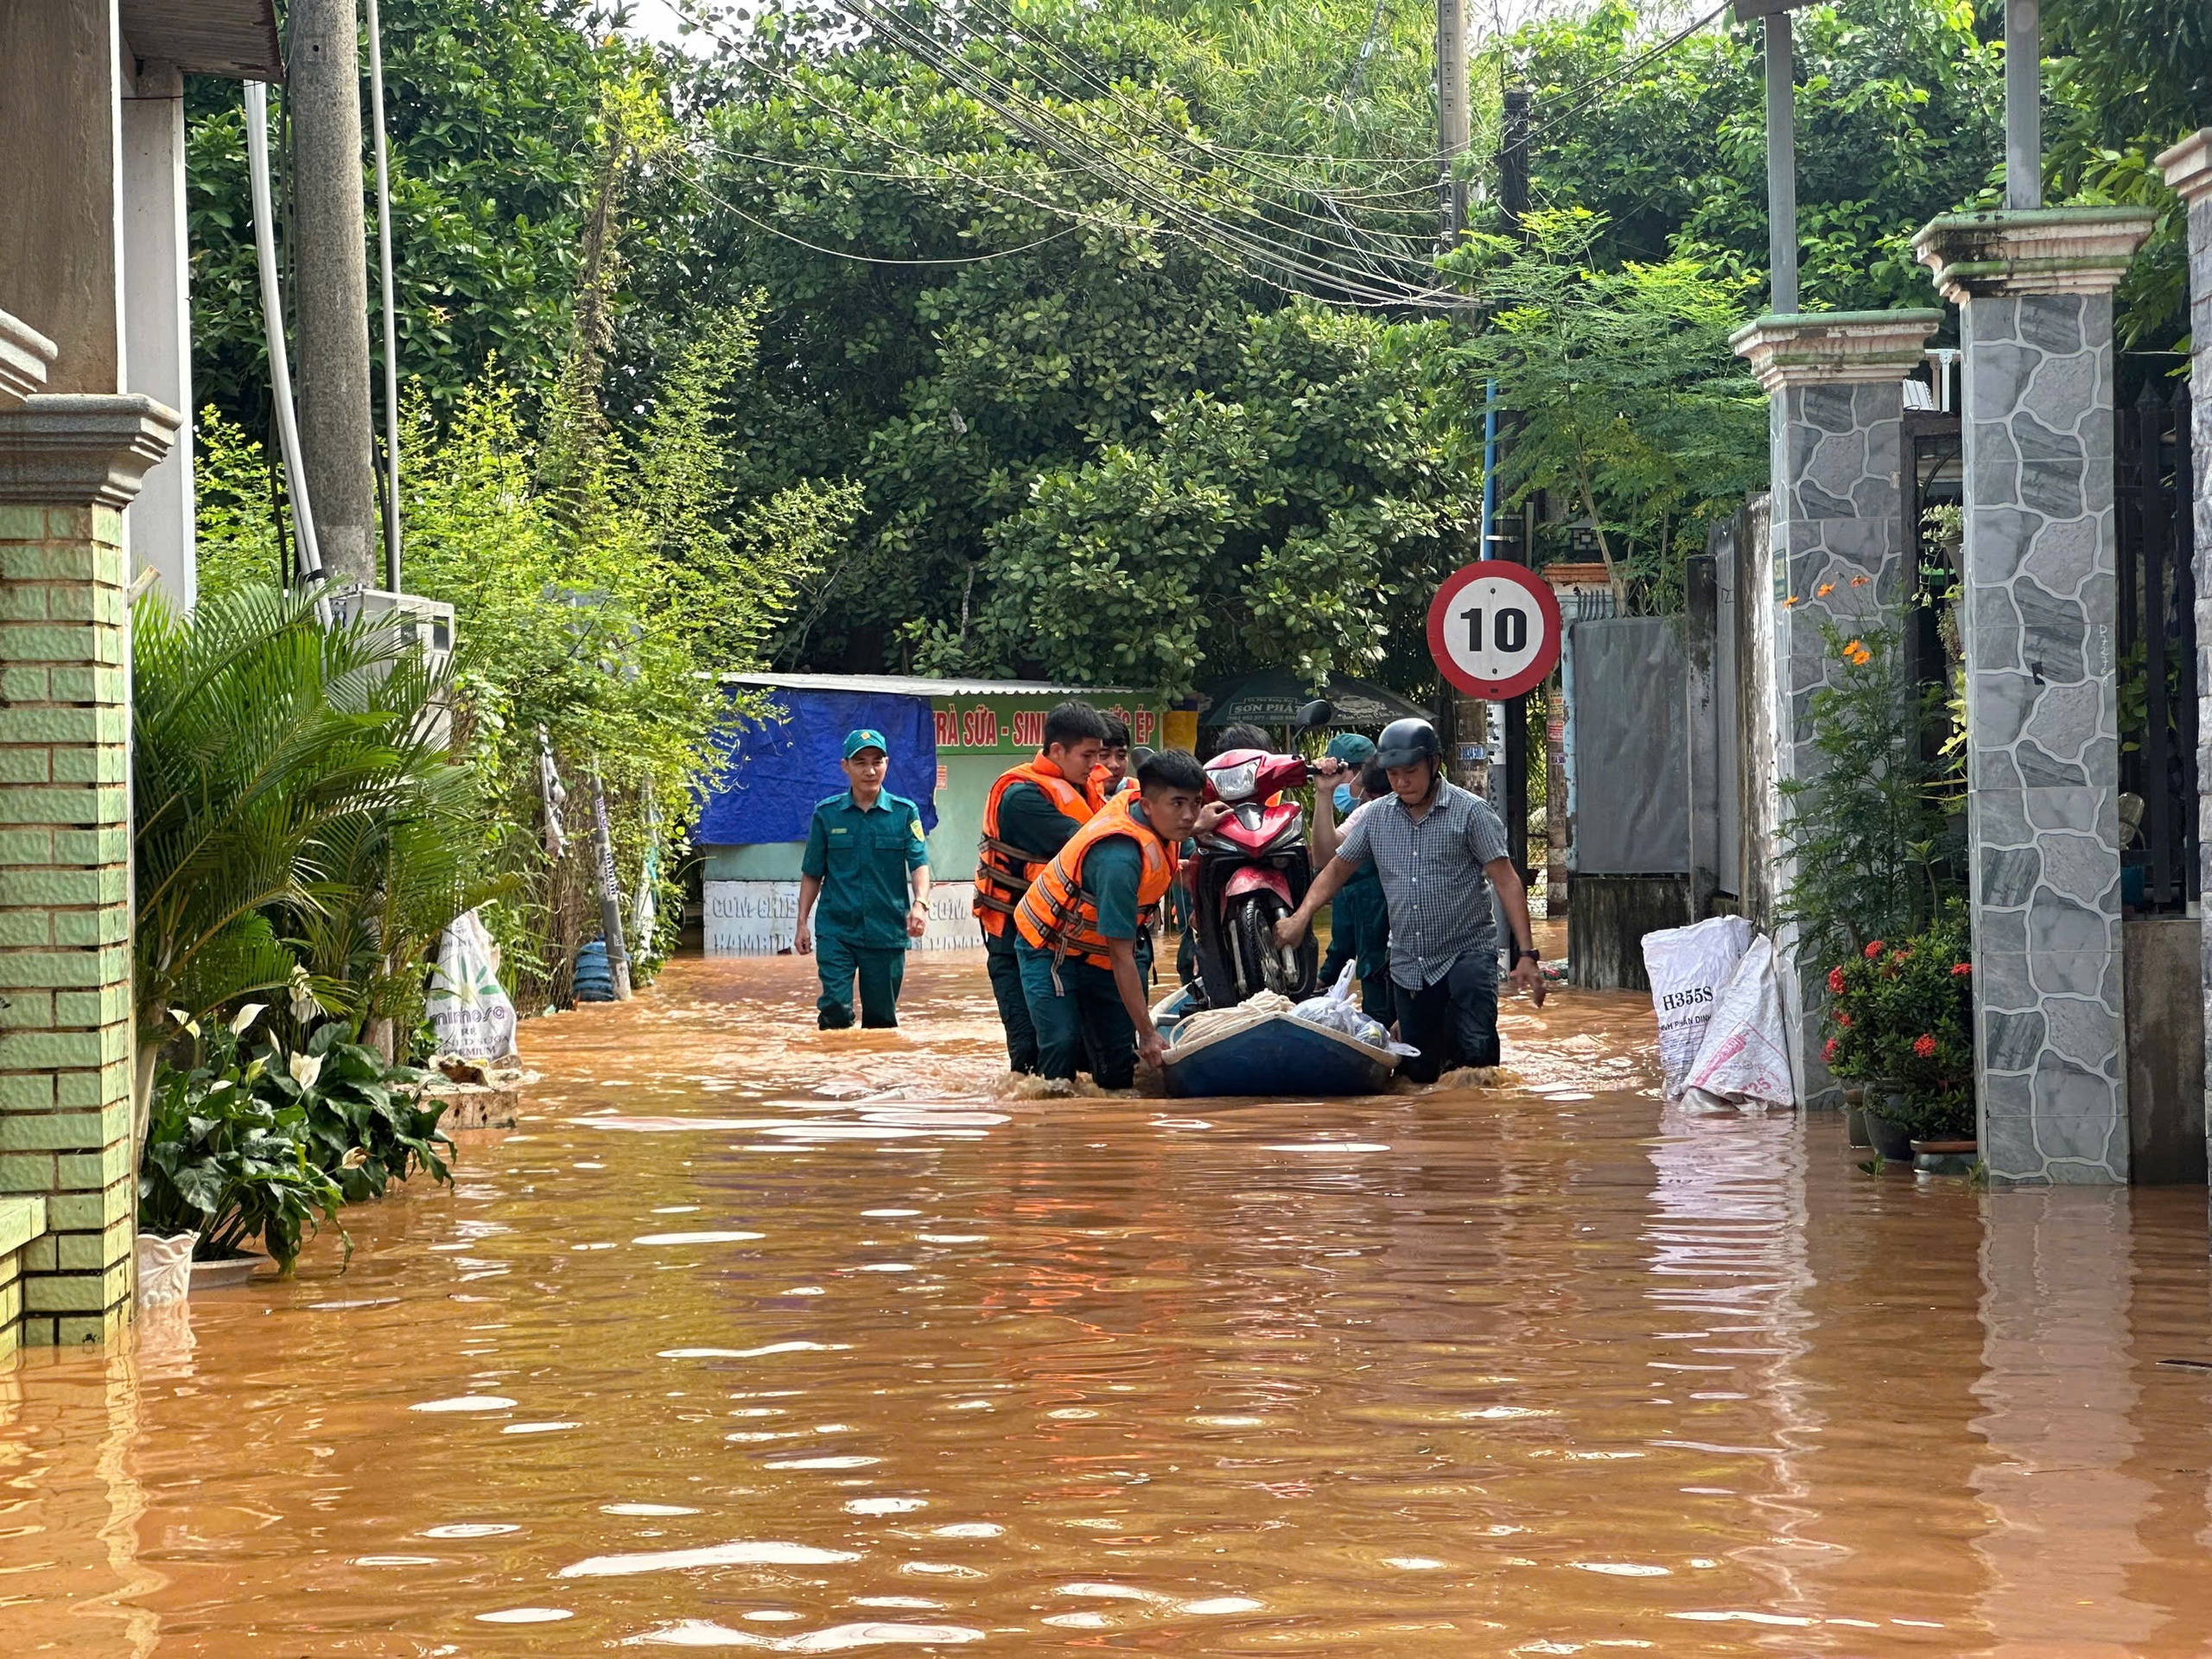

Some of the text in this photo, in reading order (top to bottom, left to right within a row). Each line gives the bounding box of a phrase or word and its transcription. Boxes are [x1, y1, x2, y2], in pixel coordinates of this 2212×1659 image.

[1460, 607, 1528, 653] 10
[963, 703, 998, 747] SỮA
[1135, 703, 1155, 745] ÉP
[1662, 985, 1713, 1011] H355S
[478, 1035, 510, 1046] SUGA
